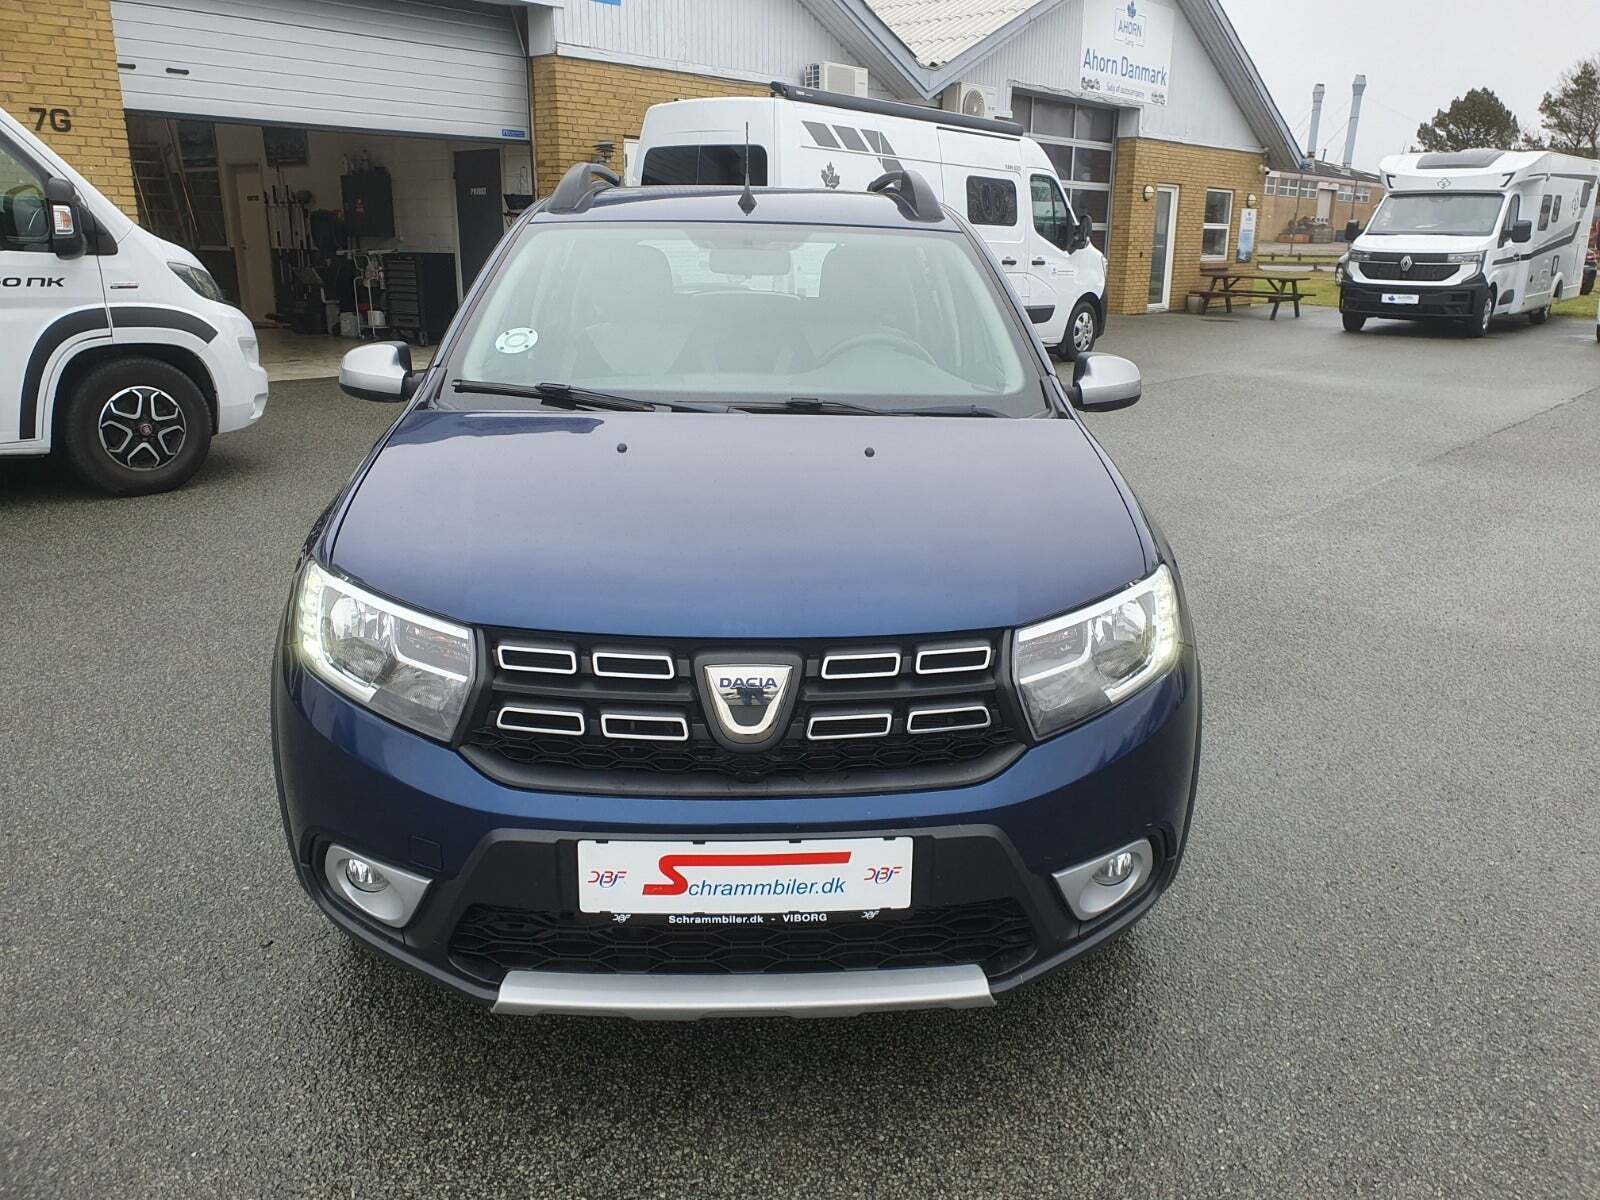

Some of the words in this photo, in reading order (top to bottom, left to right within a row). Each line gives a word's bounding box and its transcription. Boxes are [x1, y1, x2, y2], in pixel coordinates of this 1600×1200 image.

[1118, 20, 1143, 37] AHORN
[1083, 47, 1118, 75] Ahorn
[1121, 56, 1168, 86] Danmark
[29, 107, 72, 132] 7G
[719, 677, 778, 689] DACIA
[642, 851, 852, 897] Schrammbiler.dk
[668, 914, 764, 925] Schrammbiler.dk
[782, 912, 828, 923] VIBORG
